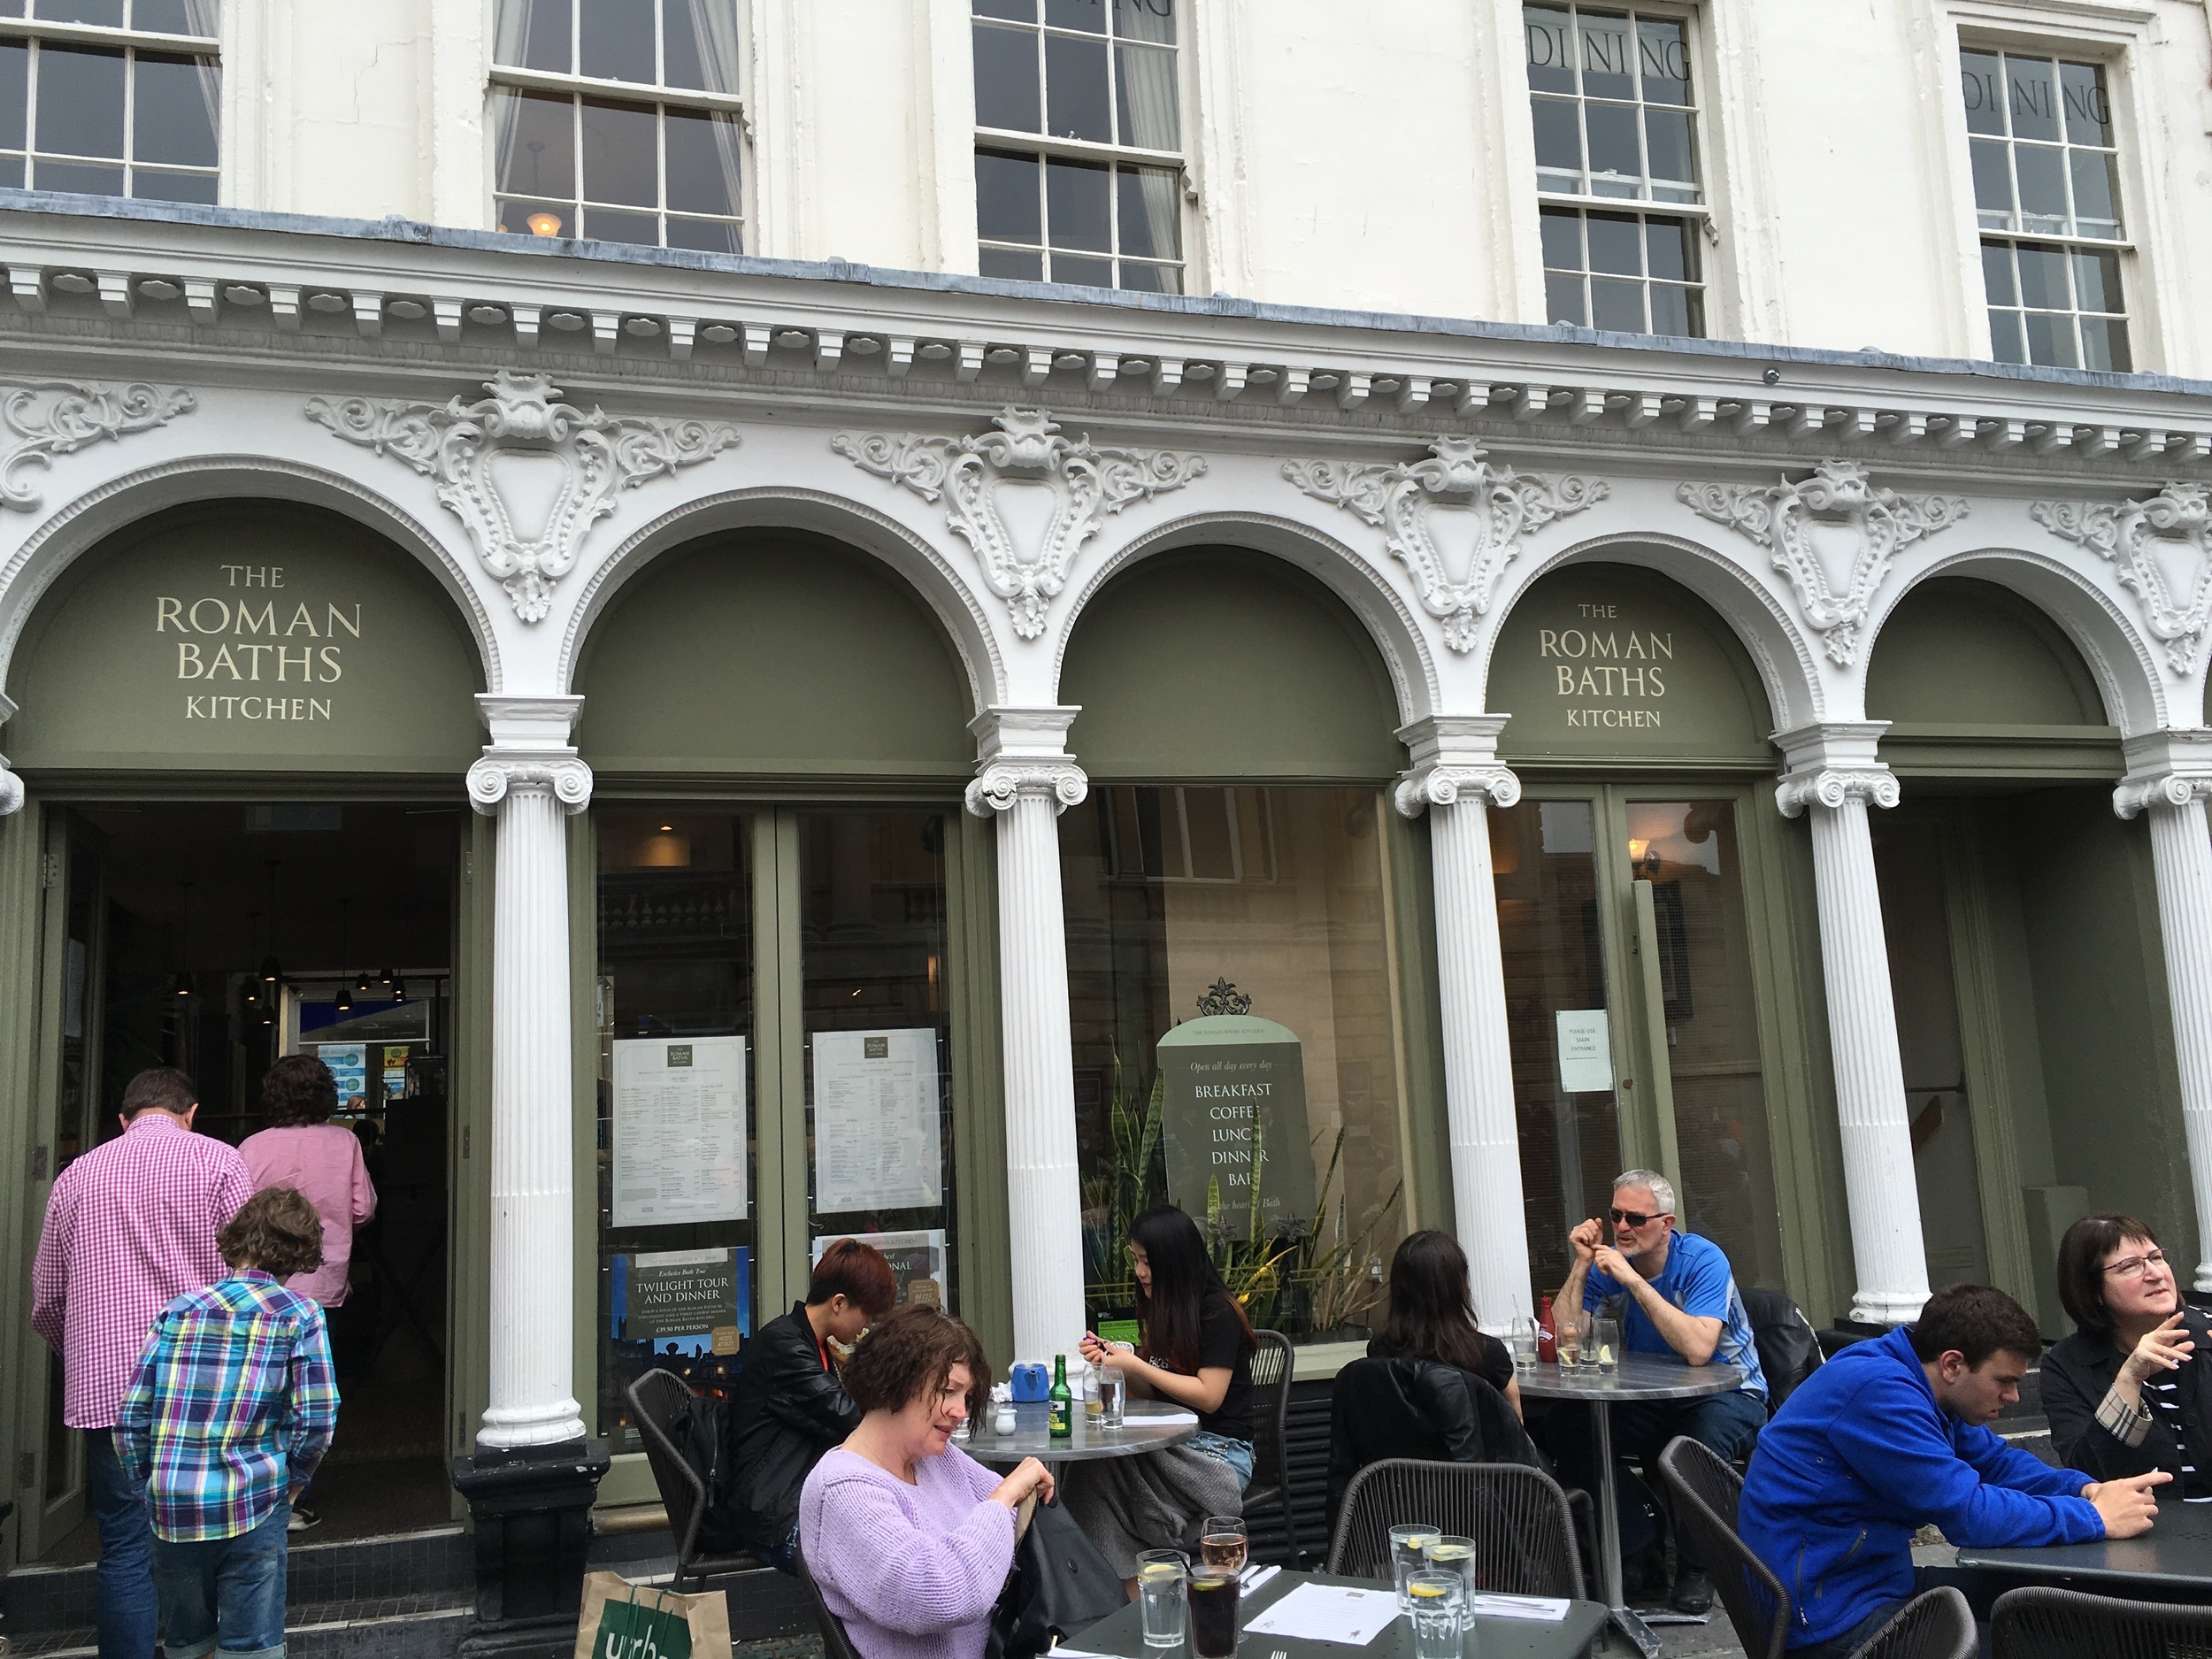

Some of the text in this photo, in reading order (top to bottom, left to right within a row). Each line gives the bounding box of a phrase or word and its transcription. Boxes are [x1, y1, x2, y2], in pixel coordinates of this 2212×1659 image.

[1526, 24, 1690, 81] DINING
[1962, 71, 2110, 125] DINING
[220, 565, 285, 588] THE
[156, 596, 361, 639] ROMAN
[1578, 603, 1617, 618] THE
[1540, 629, 1673, 660] ROMAN
[177, 642, 342, 683] BATHS
[1555, 665, 1665, 697] BATHS
[185, 695, 332, 721] KITCHEN
[1566, 709, 1661, 727] KITCHEN
[1190, 1059, 1273, 1073] Open all day every day
[1195, 1083, 1272, 1098] BREAKFAST
[1212, 1127, 1261, 1142] LUNC
[1212, 1149, 1270, 1164] DINNR
[1219, 1200, 1231, 1210] he
[1263, 1197, 1280, 1209] Bath
[636, 1277, 729, 1293] TWILIGHT TOUR
[644, 1289, 720, 1304] AND DINNER
[605, 1624, 668, 1659] urb
